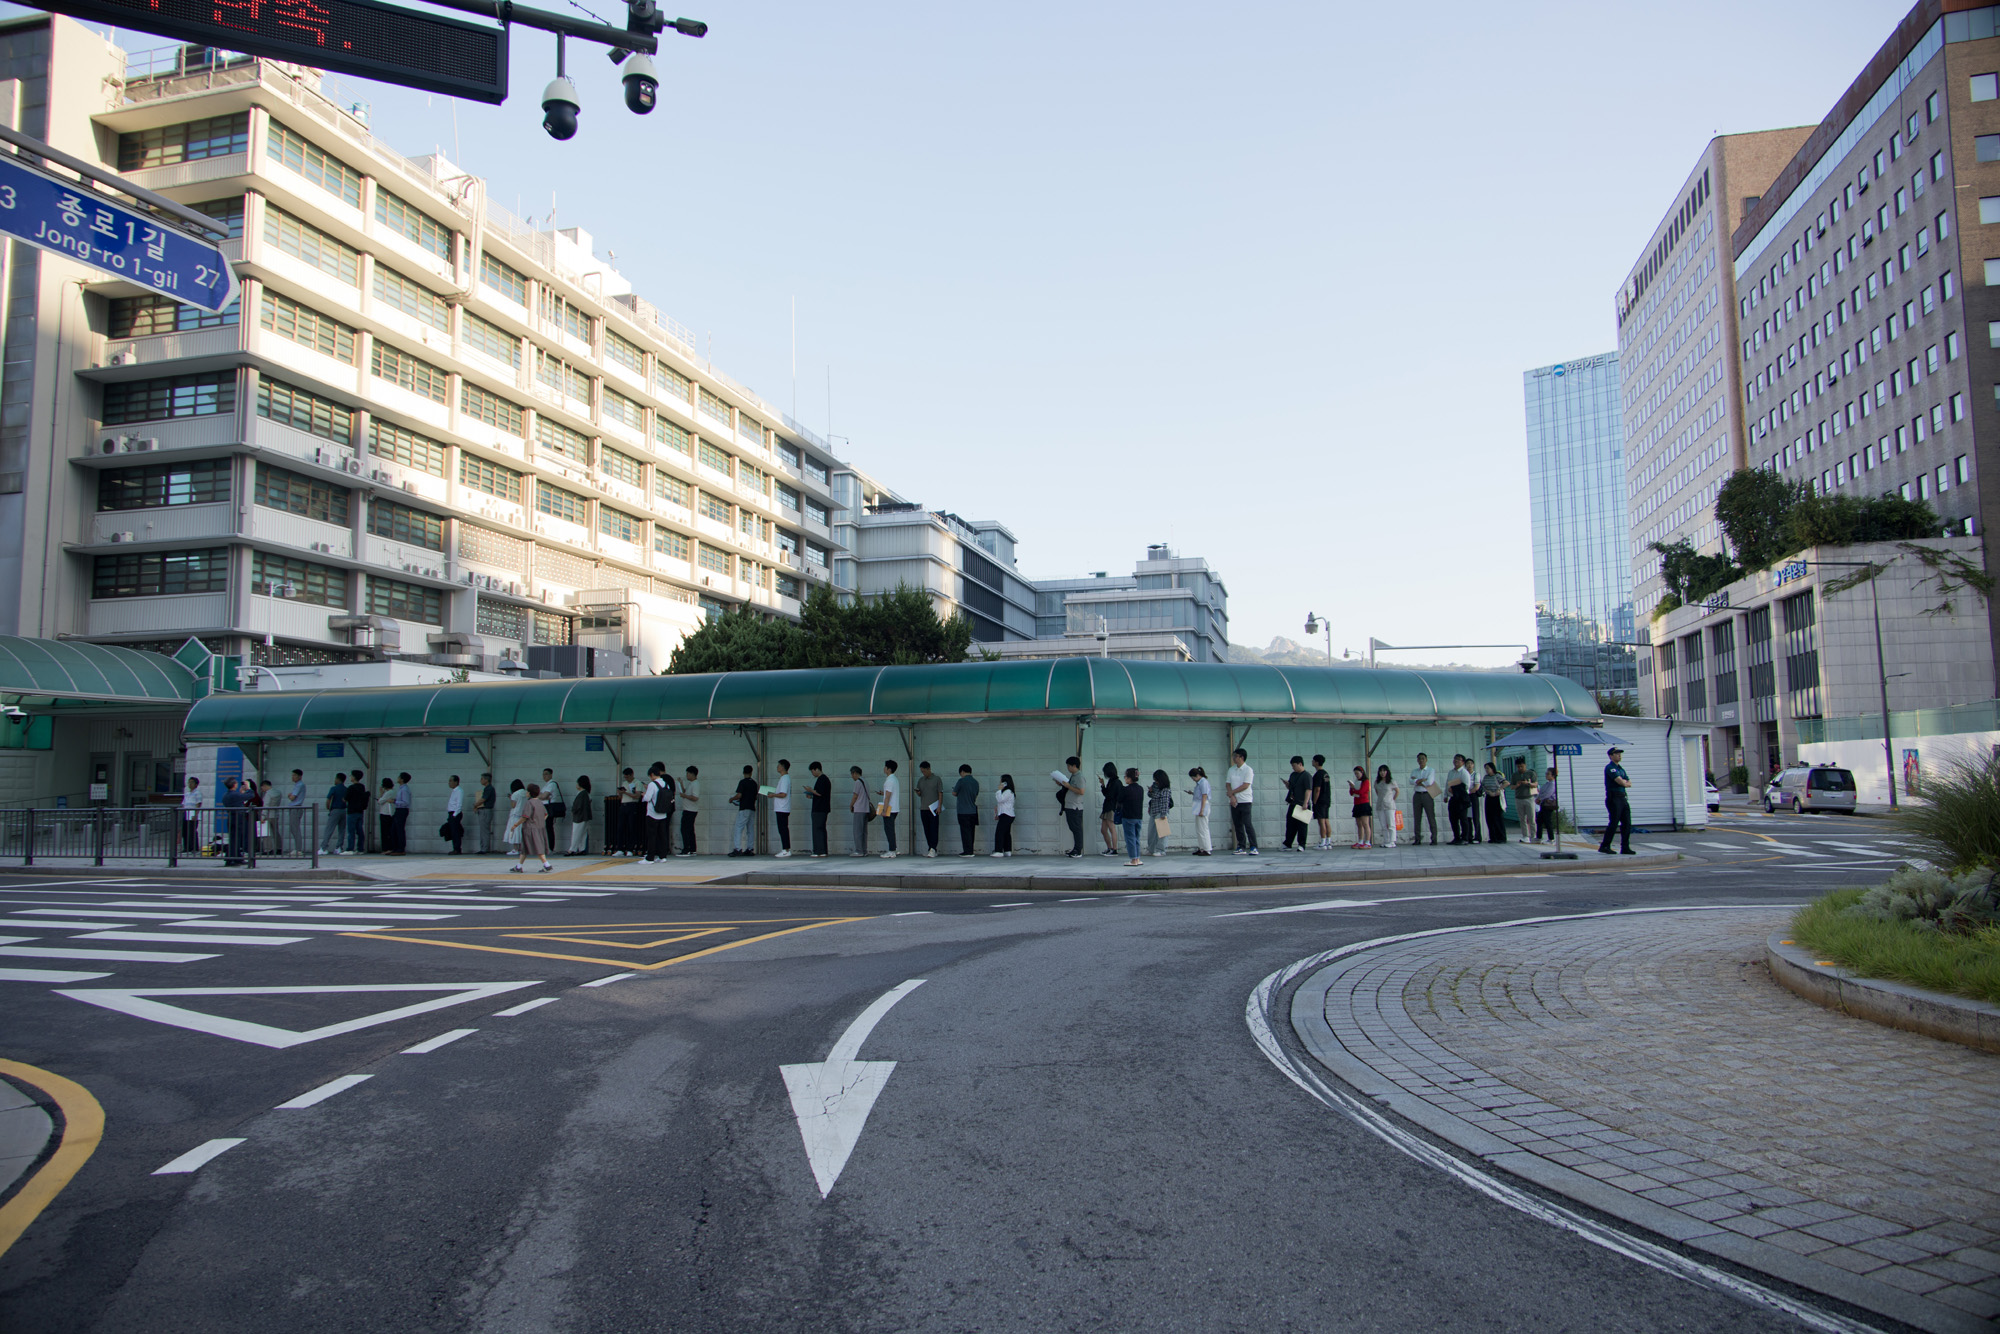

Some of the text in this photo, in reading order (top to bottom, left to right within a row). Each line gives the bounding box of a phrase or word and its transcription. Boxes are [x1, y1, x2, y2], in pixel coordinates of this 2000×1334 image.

[56, 193, 166, 262] 종로1길
[35, 221, 179, 290] Jong-ro 1-gil
[194, 265, 221, 289] 27
[1566, 356, 1605, 374] 우리카드
[1781, 560, 1807, 583] 우리은행
